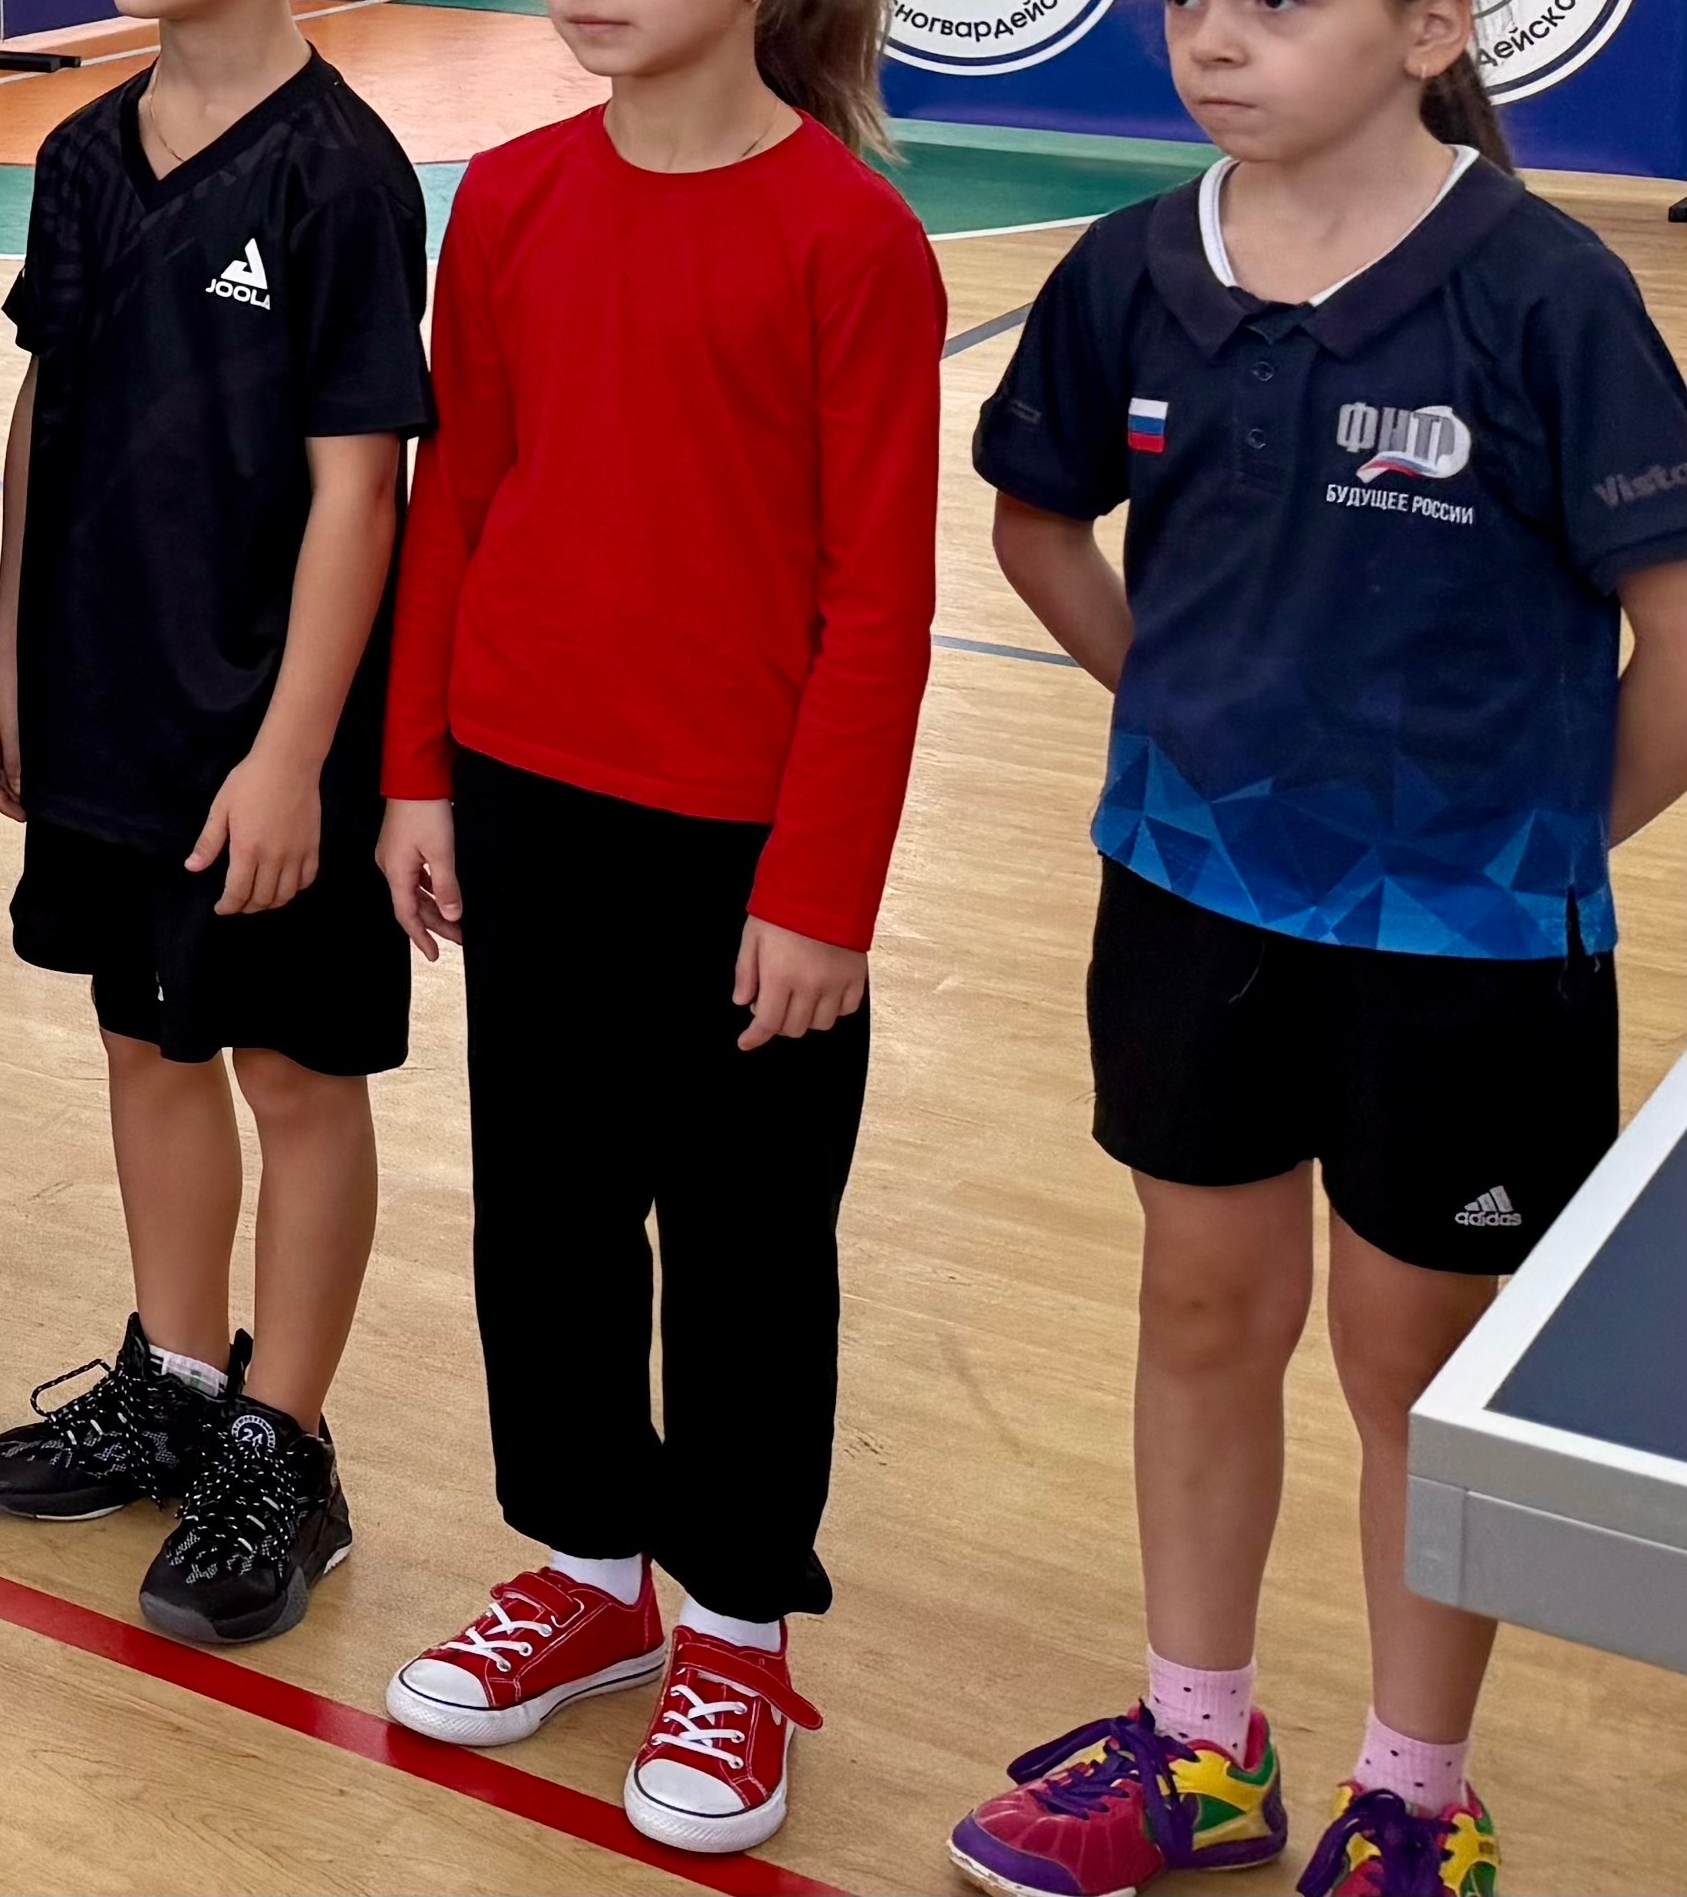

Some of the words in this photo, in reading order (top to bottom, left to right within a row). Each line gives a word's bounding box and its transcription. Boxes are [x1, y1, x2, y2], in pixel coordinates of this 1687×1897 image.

[205, 278, 271, 311] JOOLA
[1326, 484, 1409, 512] БУДУЩЕЕ
[1412, 495, 1474, 526] РОССИИ
[1454, 1211, 1523, 1227] adidas
